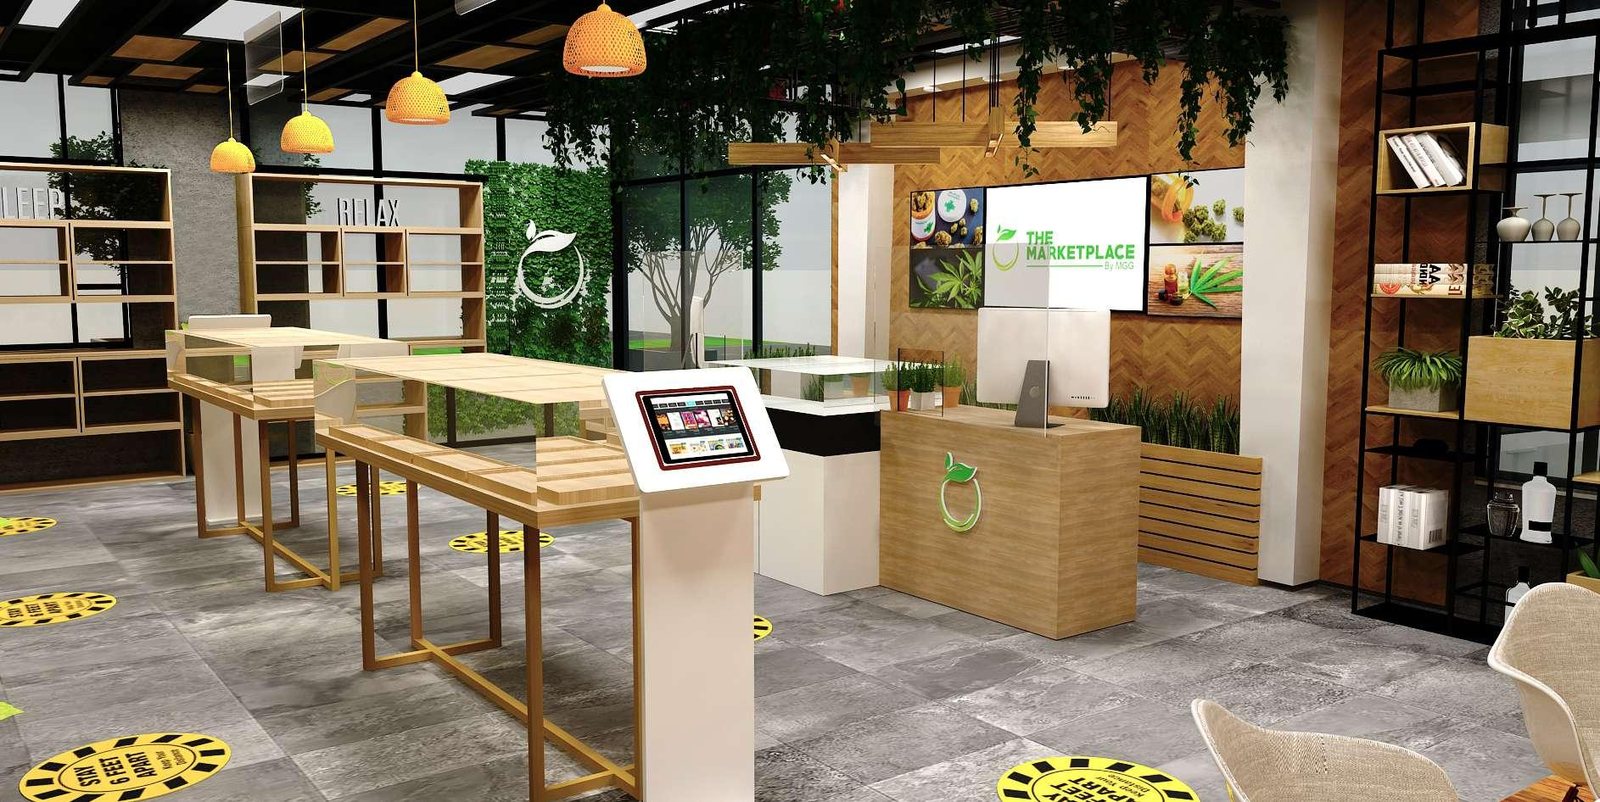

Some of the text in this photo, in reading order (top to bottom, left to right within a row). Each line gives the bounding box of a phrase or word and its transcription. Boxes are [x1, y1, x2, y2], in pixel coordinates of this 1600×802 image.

[337, 197, 399, 227] RELAX
[1026, 231, 1054, 245] THE
[1026, 244, 1135, 260] MARKETPLACE
[1104, 261, 1135, 271] By MGG
[98, 756, 130, 785] 6 FEET
[125, 752, 158, 778] APART
[73, 766, 101, 787] STAY
[1095, 776, 1145, 798] Keep Your
[1107, 774, 1151, 793] Distance
